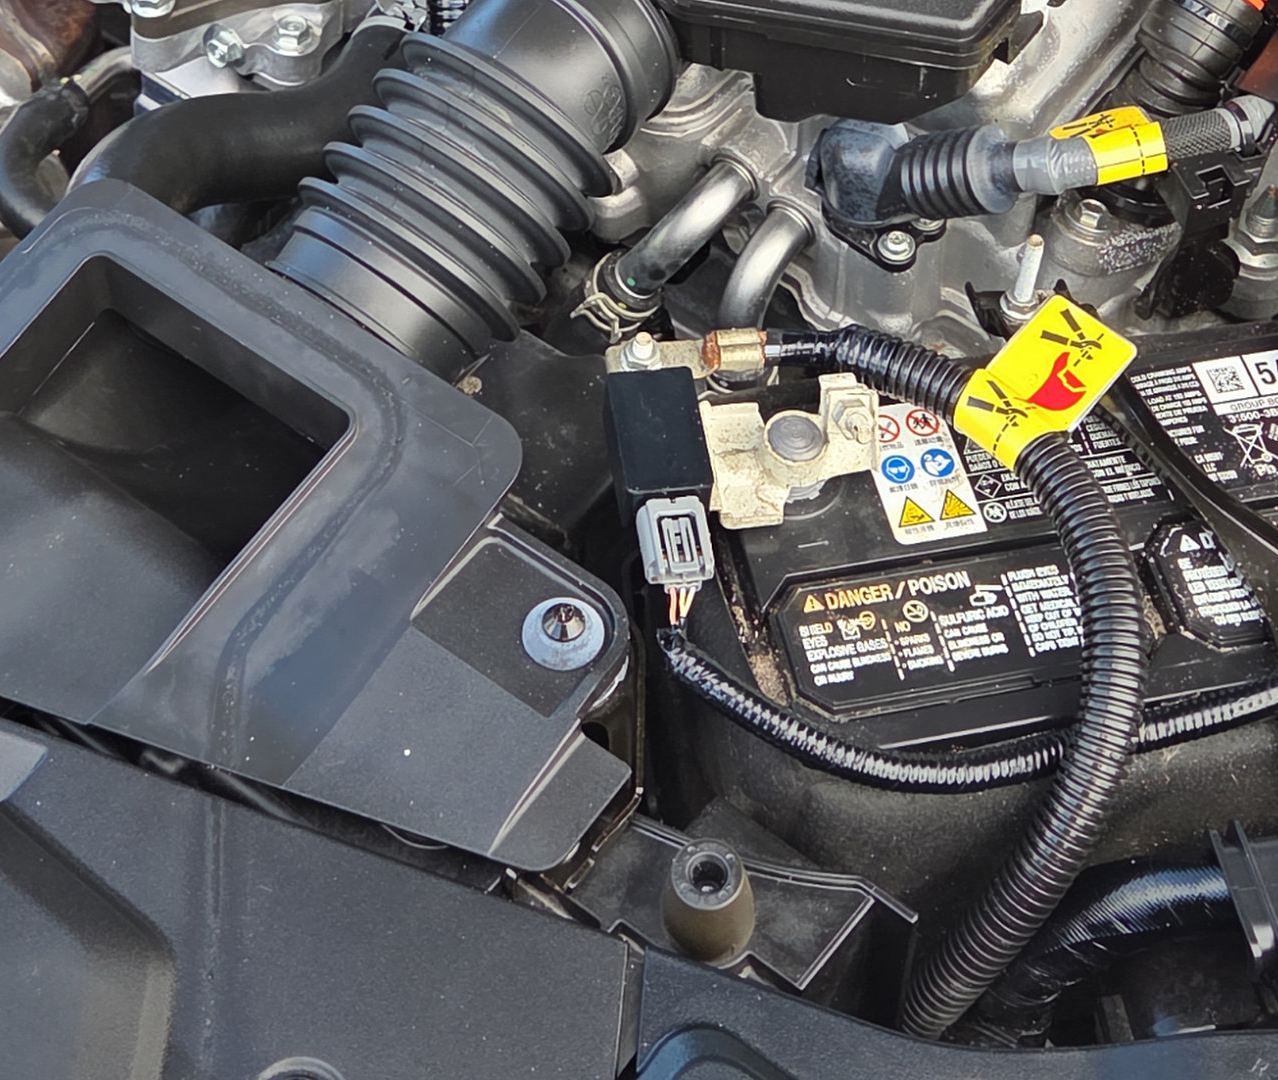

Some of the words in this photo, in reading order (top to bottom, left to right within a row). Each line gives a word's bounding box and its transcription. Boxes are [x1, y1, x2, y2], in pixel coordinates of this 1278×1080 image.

[1229, 397, 1266, 413] GROUP
[824, 582, 893, 610] DANGER
[909, 570, 971, 597] POISON
[937, 607, 985, 628] SULFURIC
[985, 604, 1009, 619] ACID
[798, 619, 834, 638] SHIELD
[893, 619, 911, 633] NO
[802, 634, 828, 650] EYES
[805, 642, 856, 663] EXPLOSIVE
[855, 636, 888, 653] GASES
